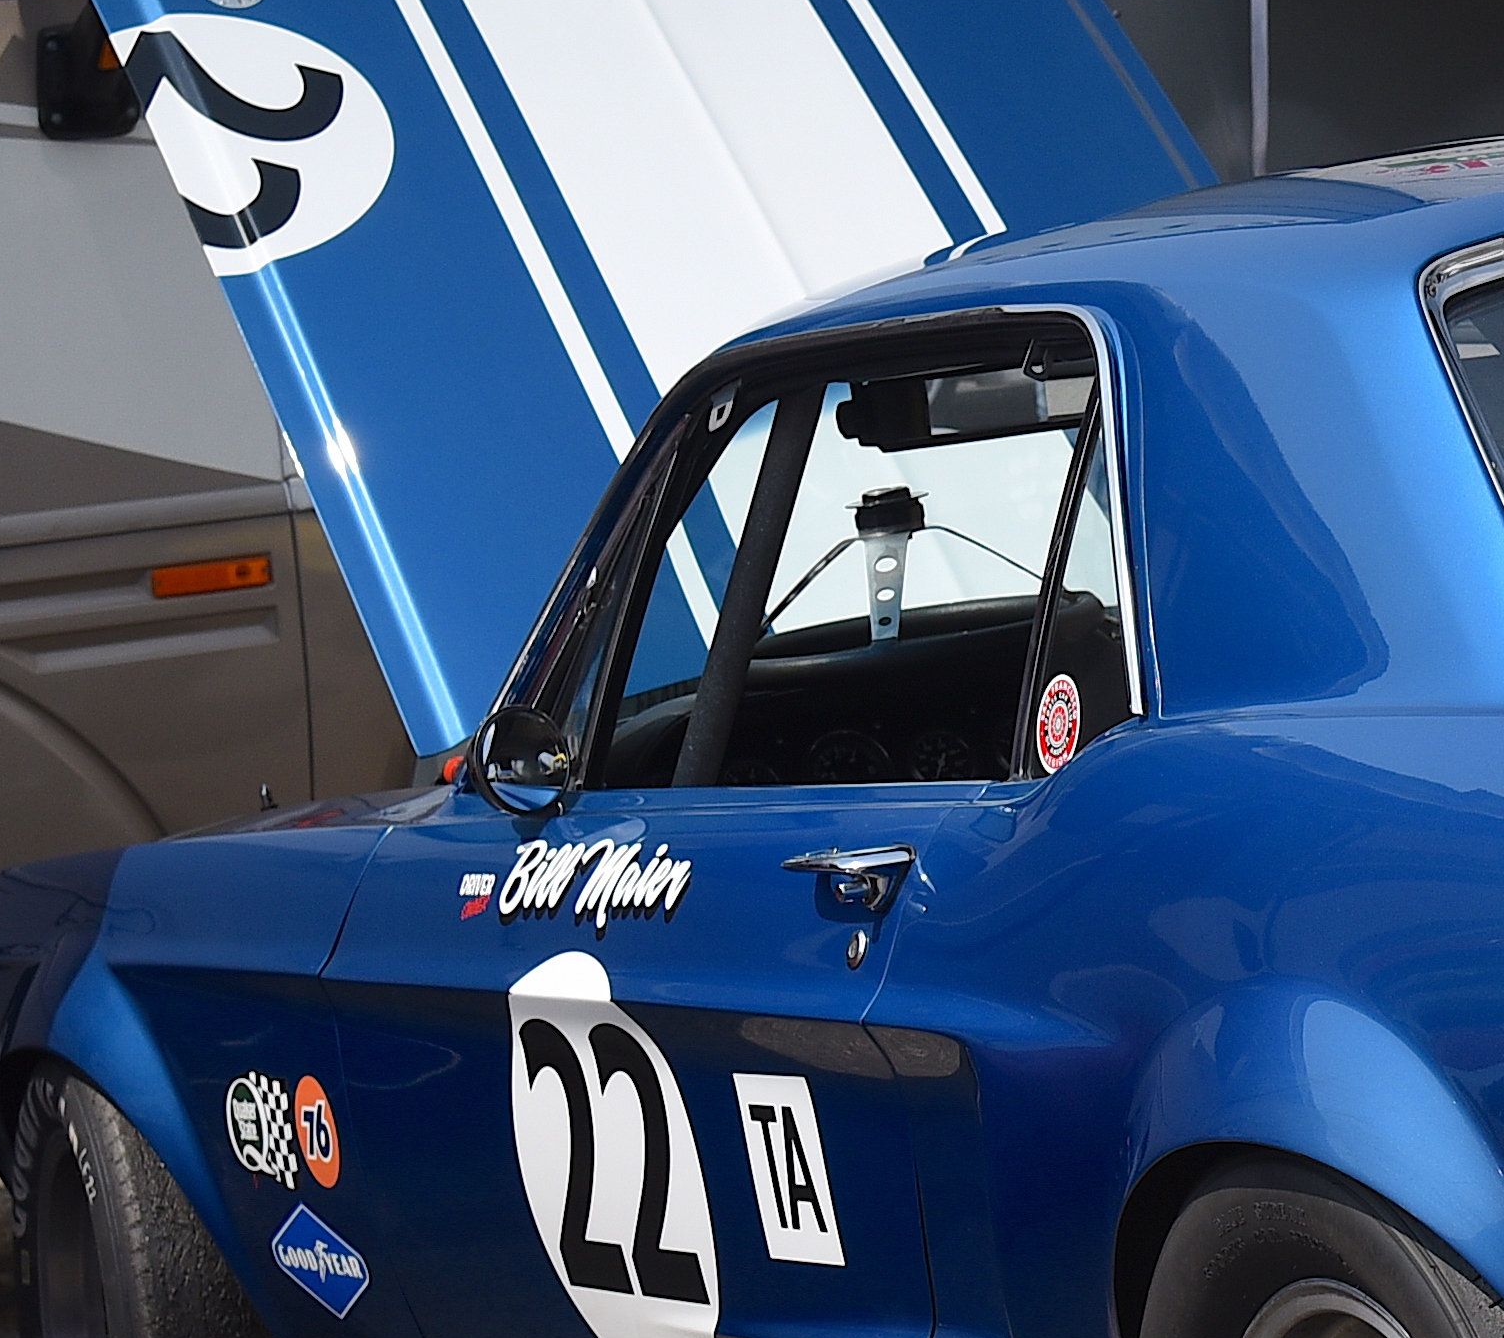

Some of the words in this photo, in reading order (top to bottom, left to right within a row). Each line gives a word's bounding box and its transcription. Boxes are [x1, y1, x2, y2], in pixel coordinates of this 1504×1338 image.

[459, 873, 496, 897] DRIVER
[499, 839, 586, 919] Bill
[574, 838, 693, 929] Maier
[301, 1099, 332, 1163] 76
[518, 1018, 711, 1306] 22
[748, 1102, 829, 1235] TA
[277, 1239, 364, 1282] GOODYEAR
